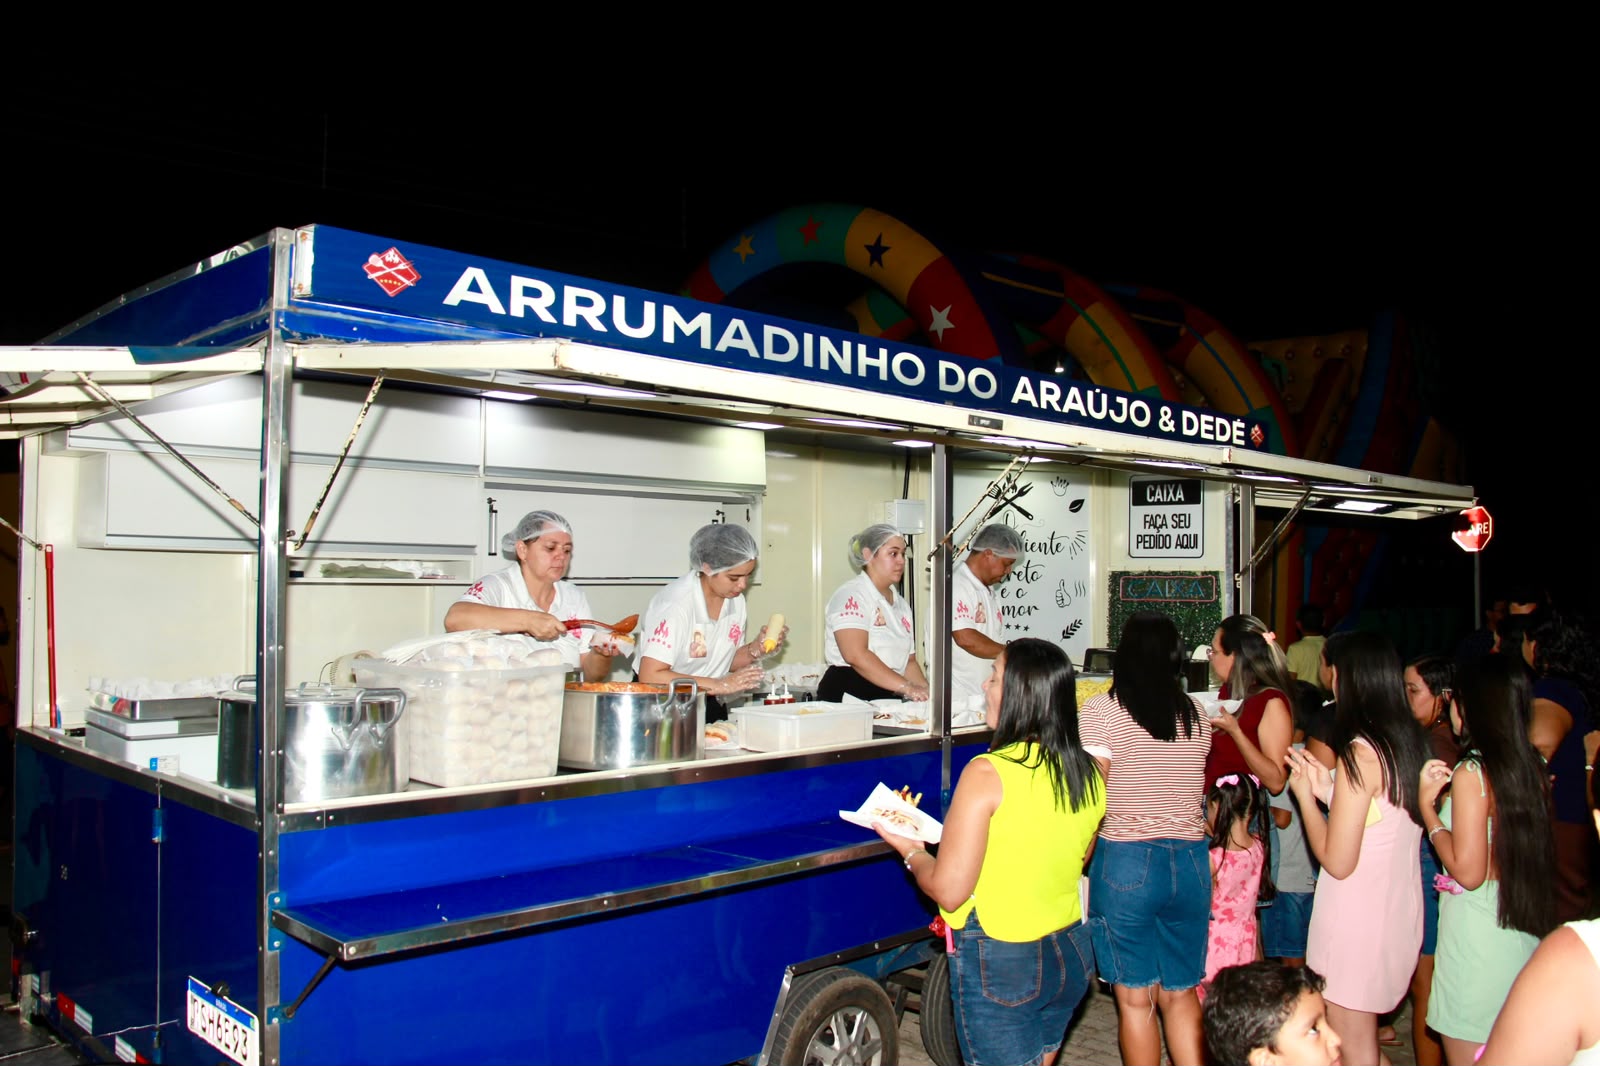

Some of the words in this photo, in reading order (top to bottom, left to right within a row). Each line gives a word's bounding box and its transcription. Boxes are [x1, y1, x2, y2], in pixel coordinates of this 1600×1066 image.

[442, 266, 926, 386] ARRUMADINHO
[938, 359, 998, 399] DO
[1010, 366, 1151, 428] ARAÚJO
[1158, 405, 1176, 433] &
[1181, 410, 1246, 446] DEDÉ
[1146, 484, 1185, 503] CAIXA
[1143, 513, 1168, 533] FAÇA
[1171, 513, 1191, 530] SEU
[1136, 533, 1172, 550] PEDIDO
[1174, 533, 1199, 550] AQUI
[1127, 579, 1206, 599] CAIXA
[1001, 604, 1039, 619] mor
